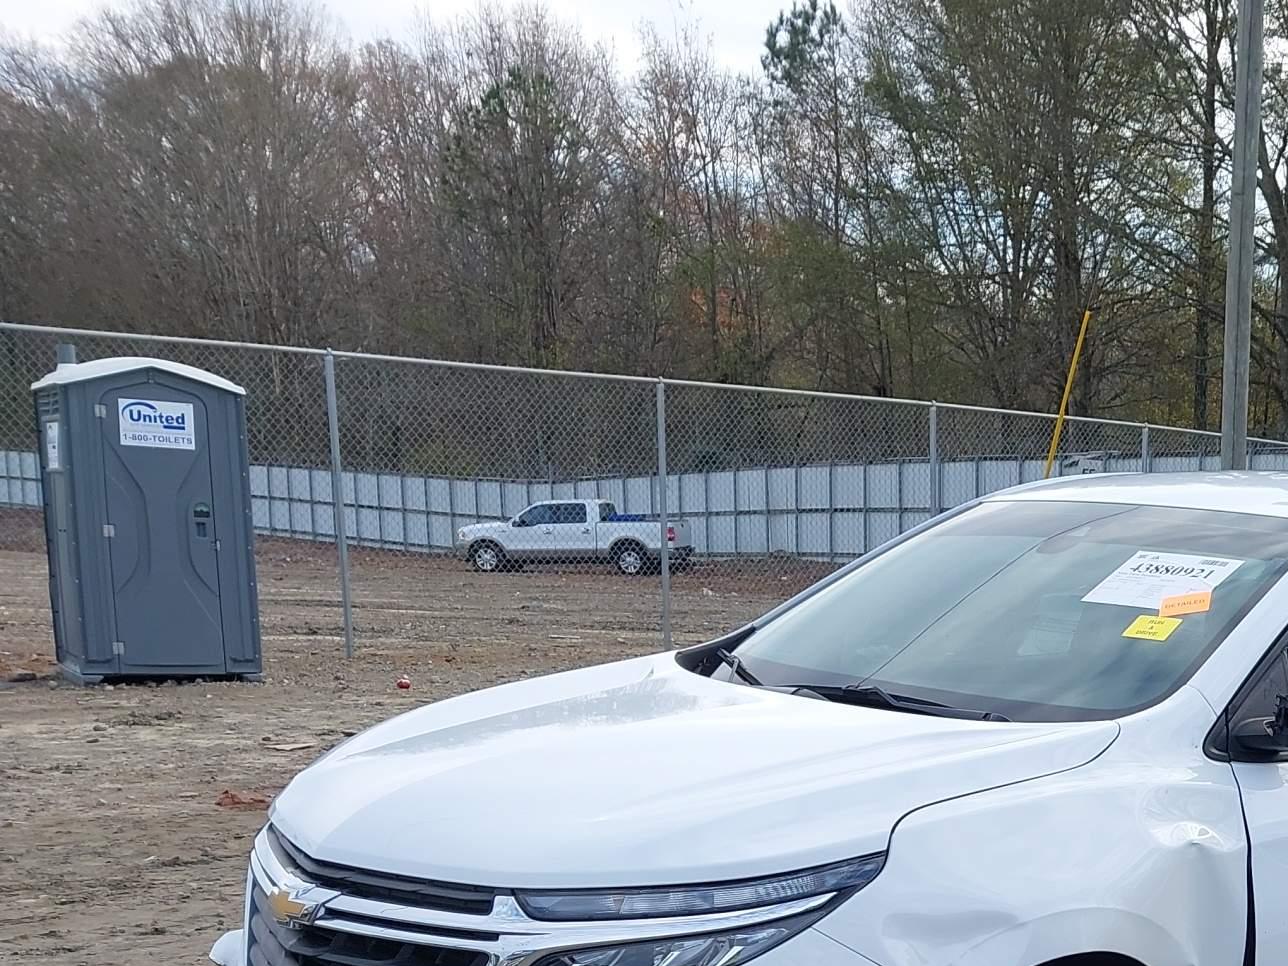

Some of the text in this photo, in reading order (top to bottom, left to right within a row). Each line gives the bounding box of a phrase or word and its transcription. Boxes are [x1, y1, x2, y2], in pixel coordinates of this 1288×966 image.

[129, 409, 185, 425] United
[123, 433, 192, 444] 1-800-TOILETS
[1130, 562, 1215, 579] 43880921
